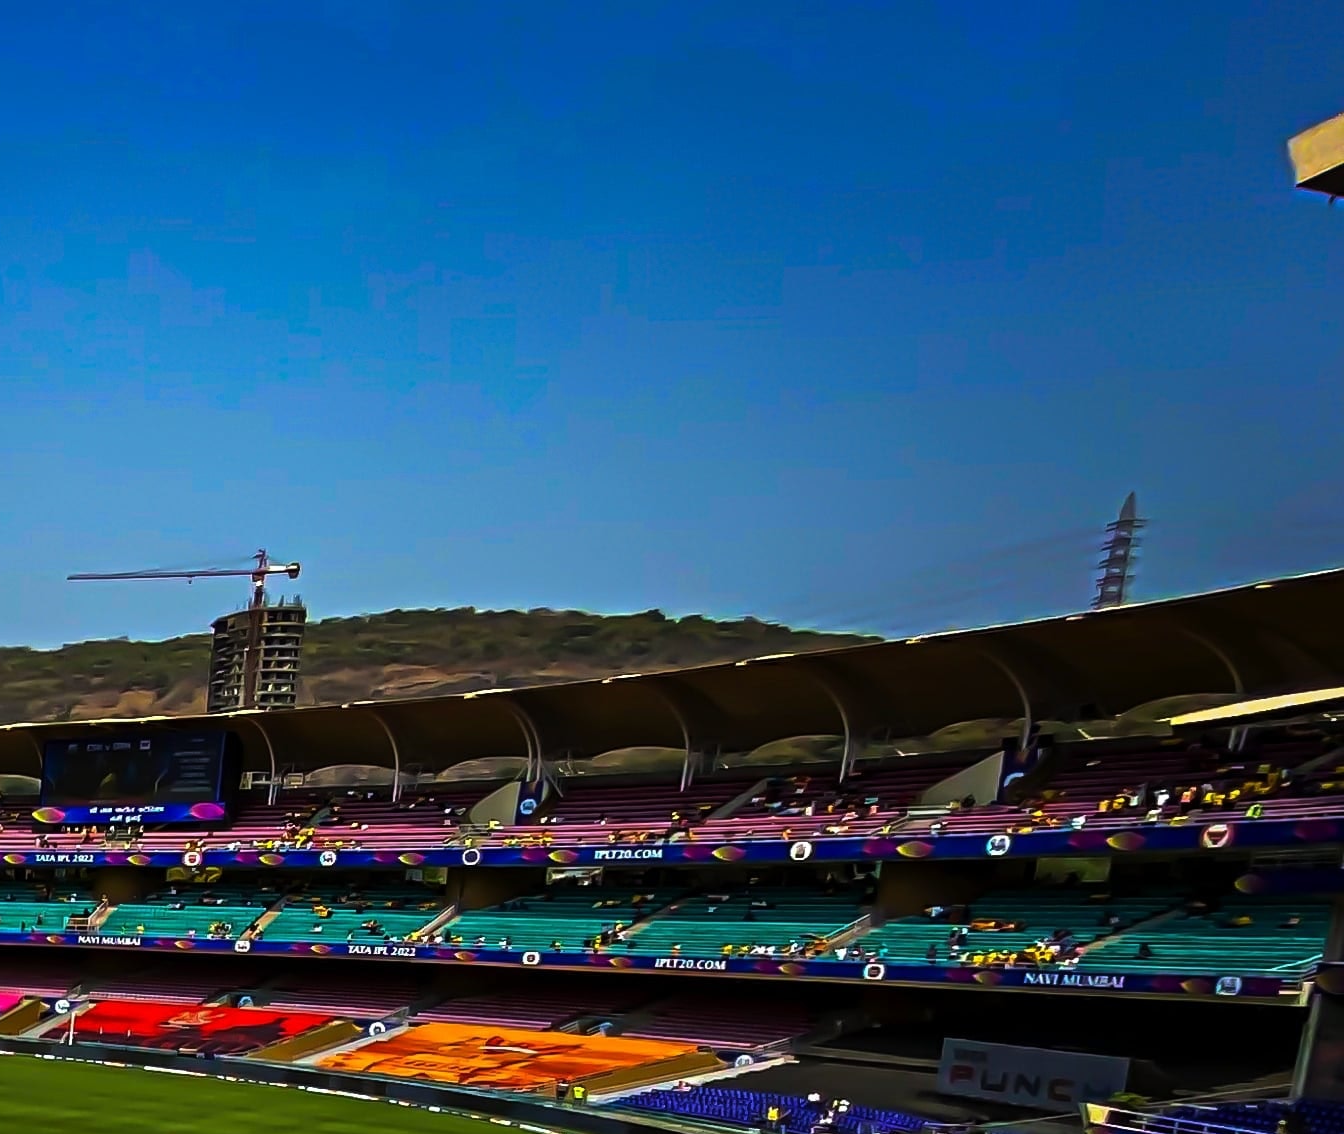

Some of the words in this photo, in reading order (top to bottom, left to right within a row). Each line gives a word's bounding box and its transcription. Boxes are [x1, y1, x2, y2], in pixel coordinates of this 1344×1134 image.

[35, 854, 56, 862] TATA
[57, 855, 71, 863] IPL
[594, 849, 663, 860] IPLT20.COM
[348, 945, 372, 955] TATA
[373, 946, 389, 955] IPL
[390, 947, 417, 957] 2022
[654, 957, 728, 971] IPLT20.COM
[1023, 972, 1059, 986] NAVI
[1061, 974, 1126, 989] MUMBAI
[950, 1064, 1111, 1102] PUNCH
